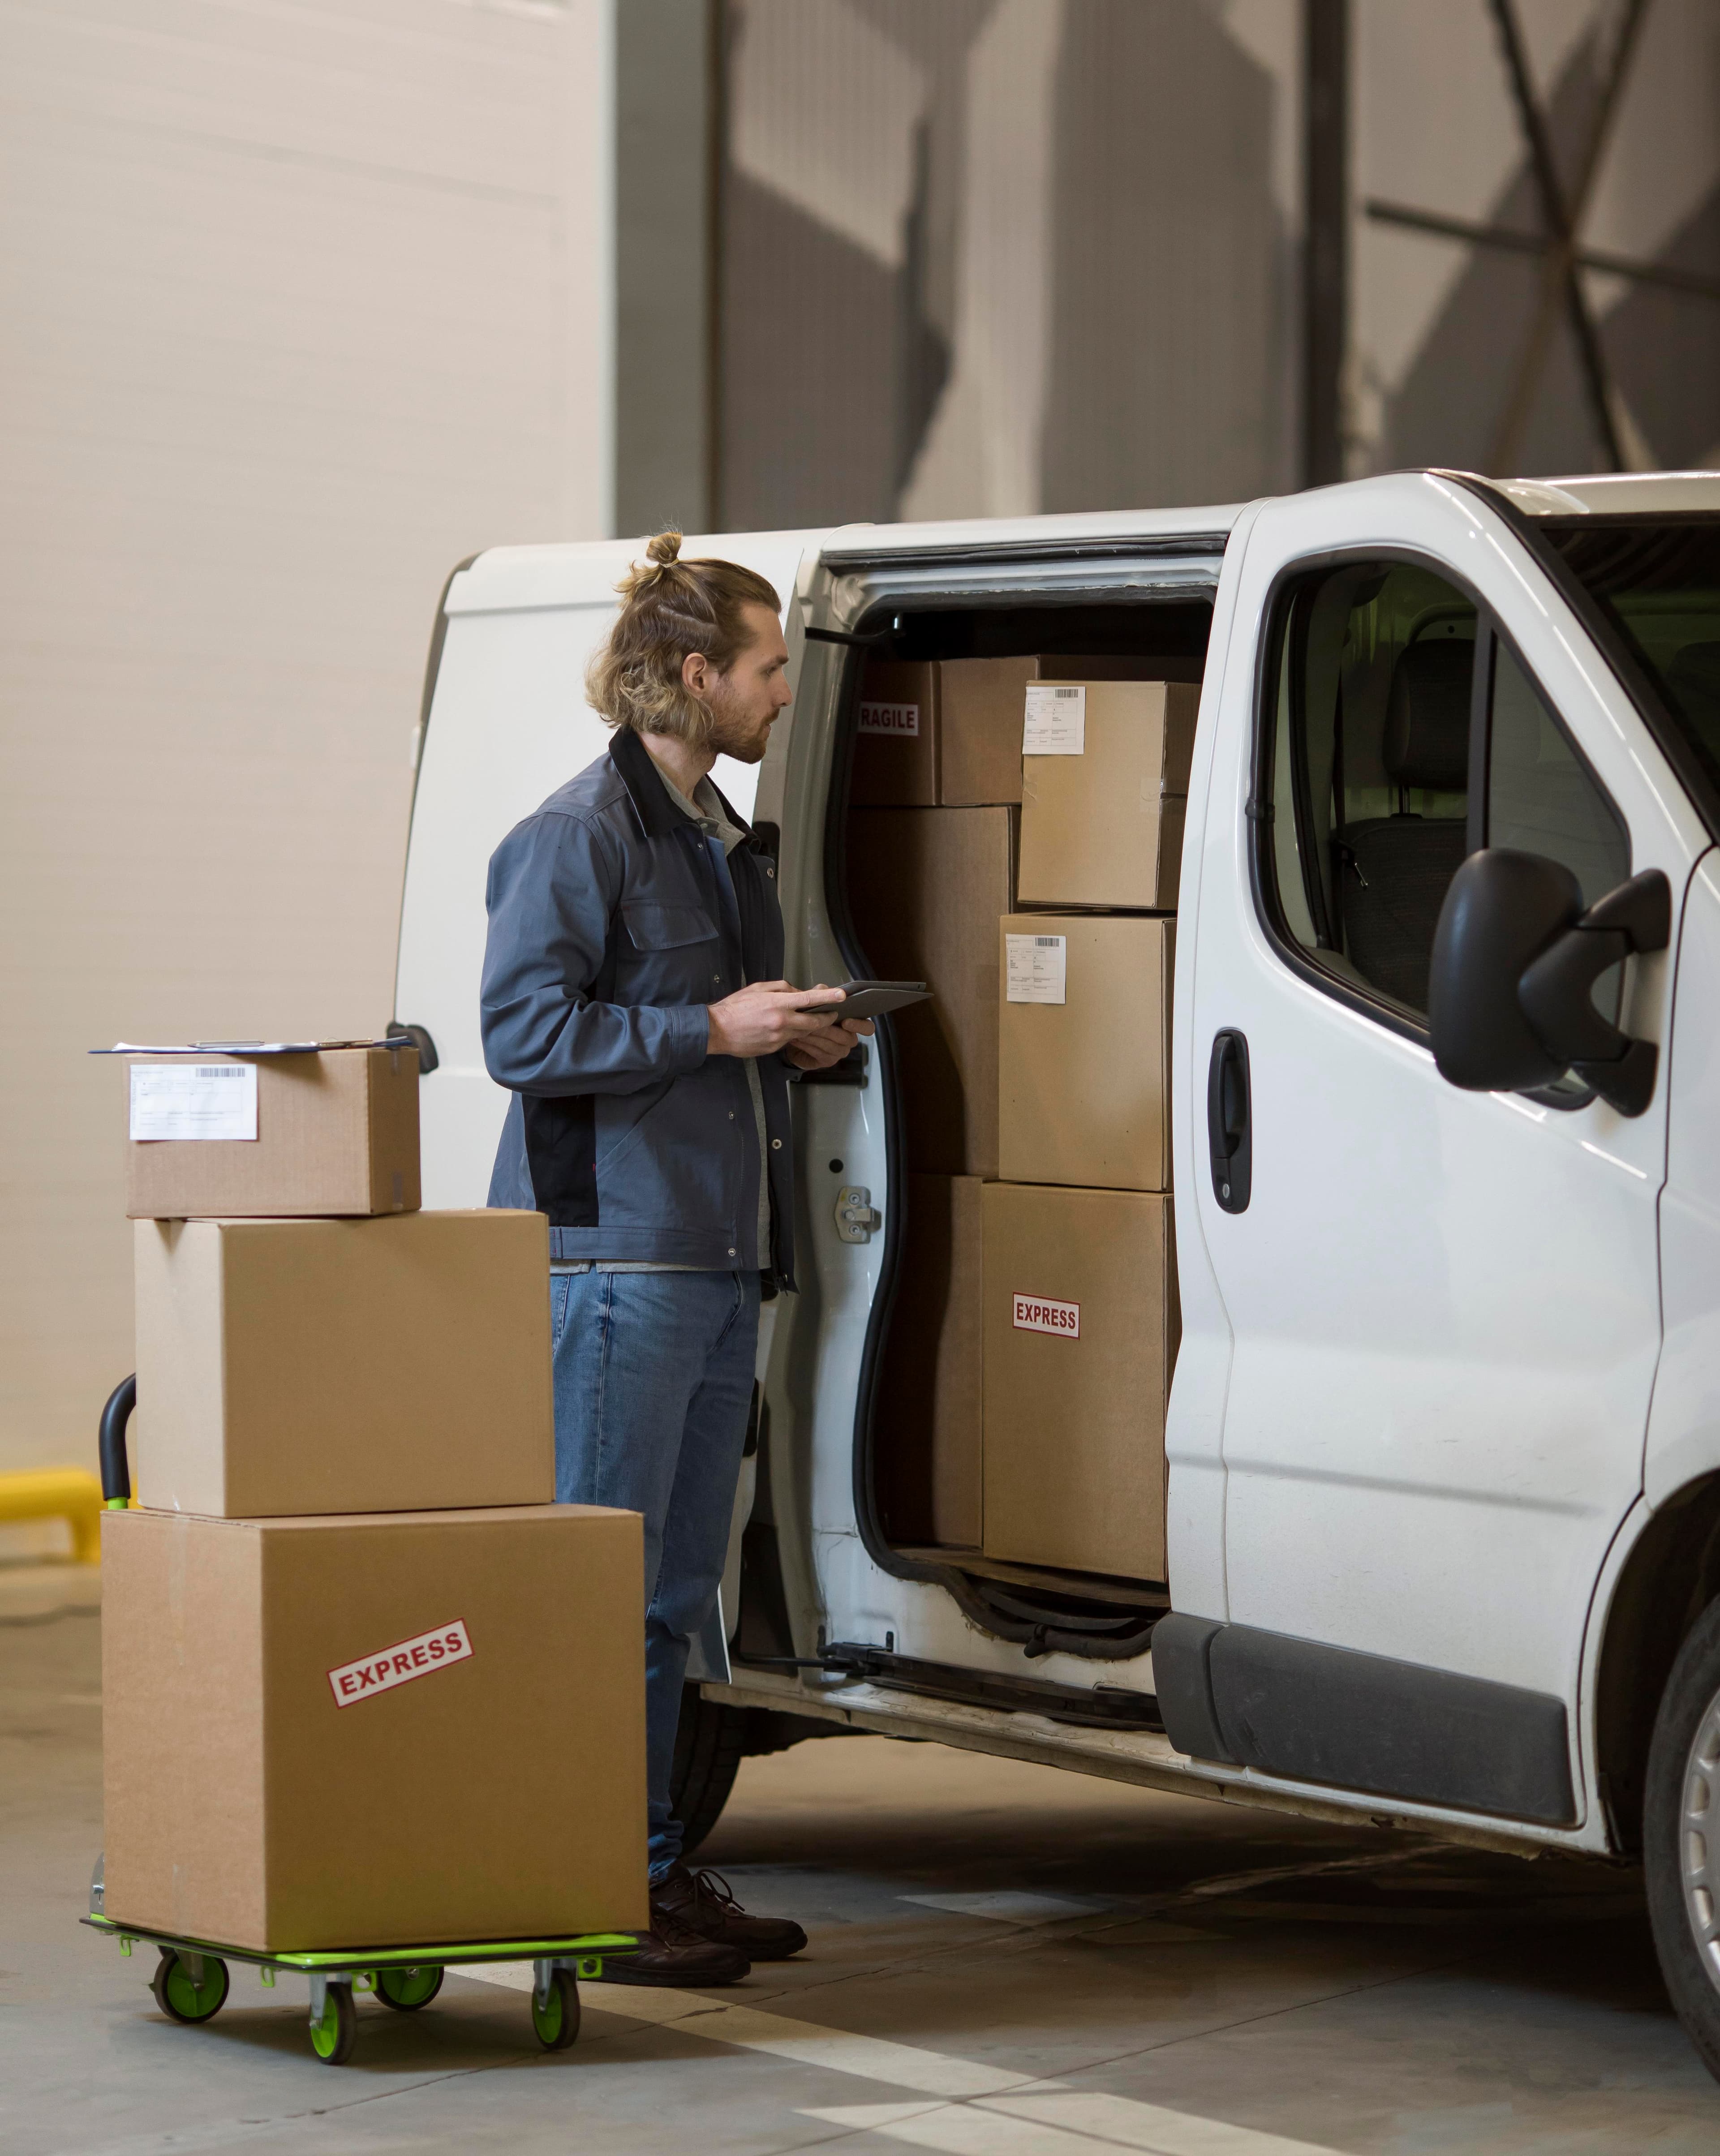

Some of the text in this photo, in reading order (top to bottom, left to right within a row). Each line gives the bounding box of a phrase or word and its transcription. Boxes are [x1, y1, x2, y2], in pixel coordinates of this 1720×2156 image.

[862, 708, 914, 728] RAGILE
[1016, 1302, 1076, 1330] EXPRESS
[338, 1632, 462, 1696] EXPRESS
